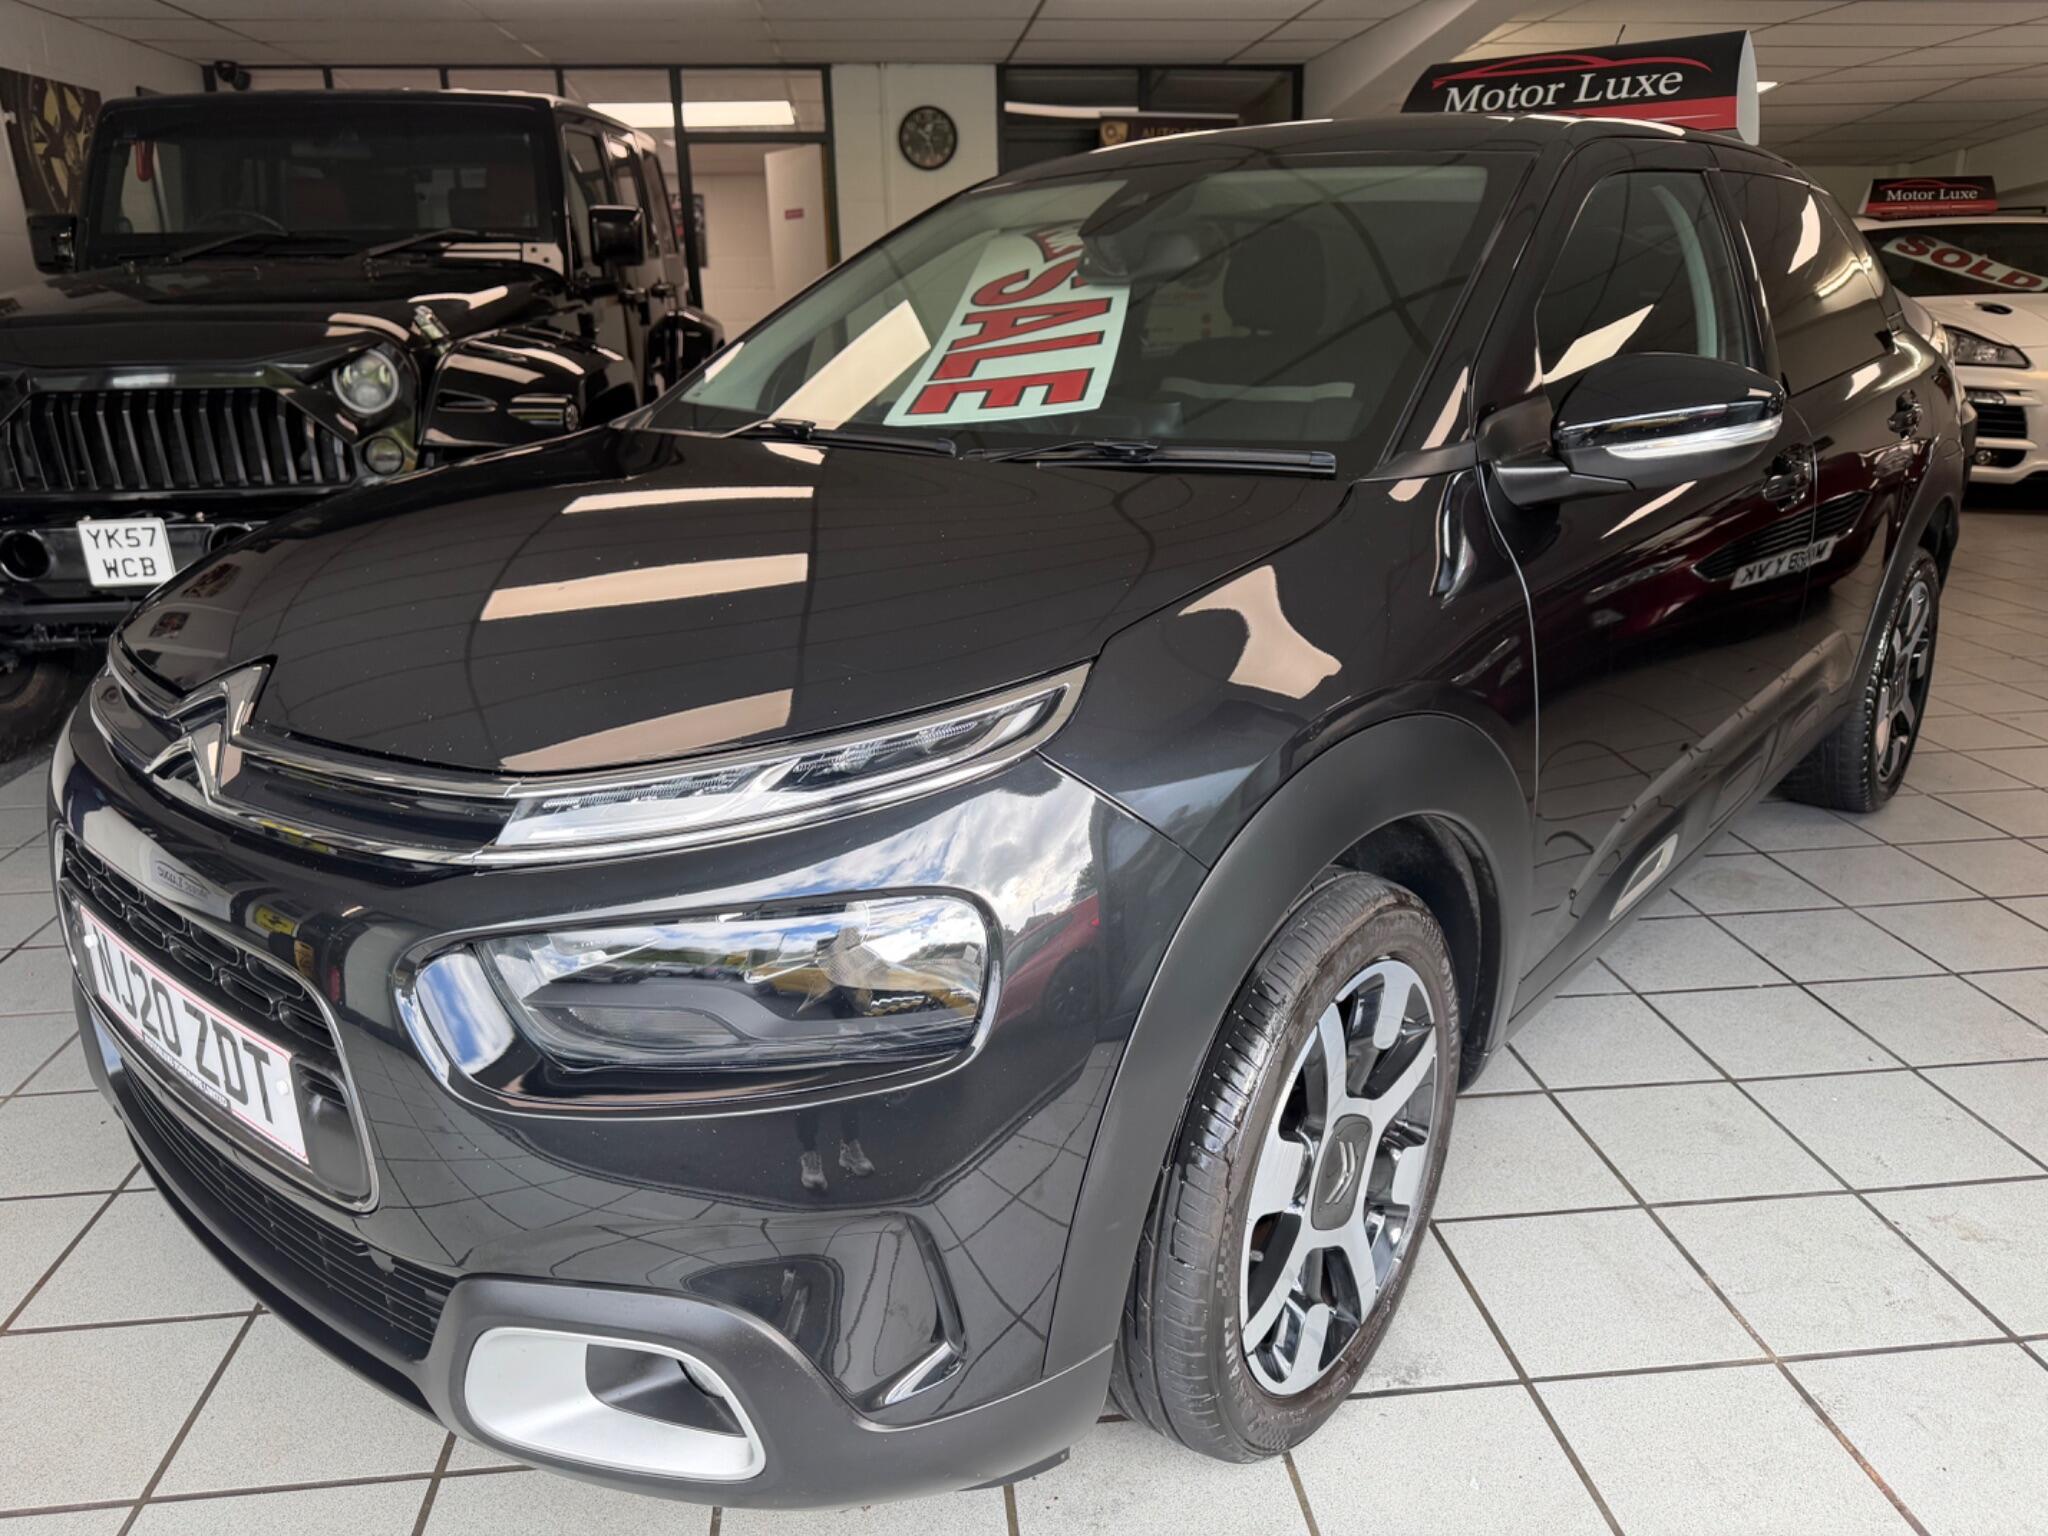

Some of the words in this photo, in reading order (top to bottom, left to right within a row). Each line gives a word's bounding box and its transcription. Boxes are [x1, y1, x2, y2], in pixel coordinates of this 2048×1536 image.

[1444, 81, 1565, 113] Motor
[1573, 70, 1683, 104] Luxe
[1886, 189, 1935, 201] Motor
[1939, 188, 1979, 200] Luxe
[1895, 234, 2043, 288] SOLD
[904, 256, 1114, 415] SALE
[86, 527, 156, 549] YK57
[102, 557, 156, 579] WCB
[92, 923, 182, 1058] NJ20
[183, 999, 274, 1125] ZDT
